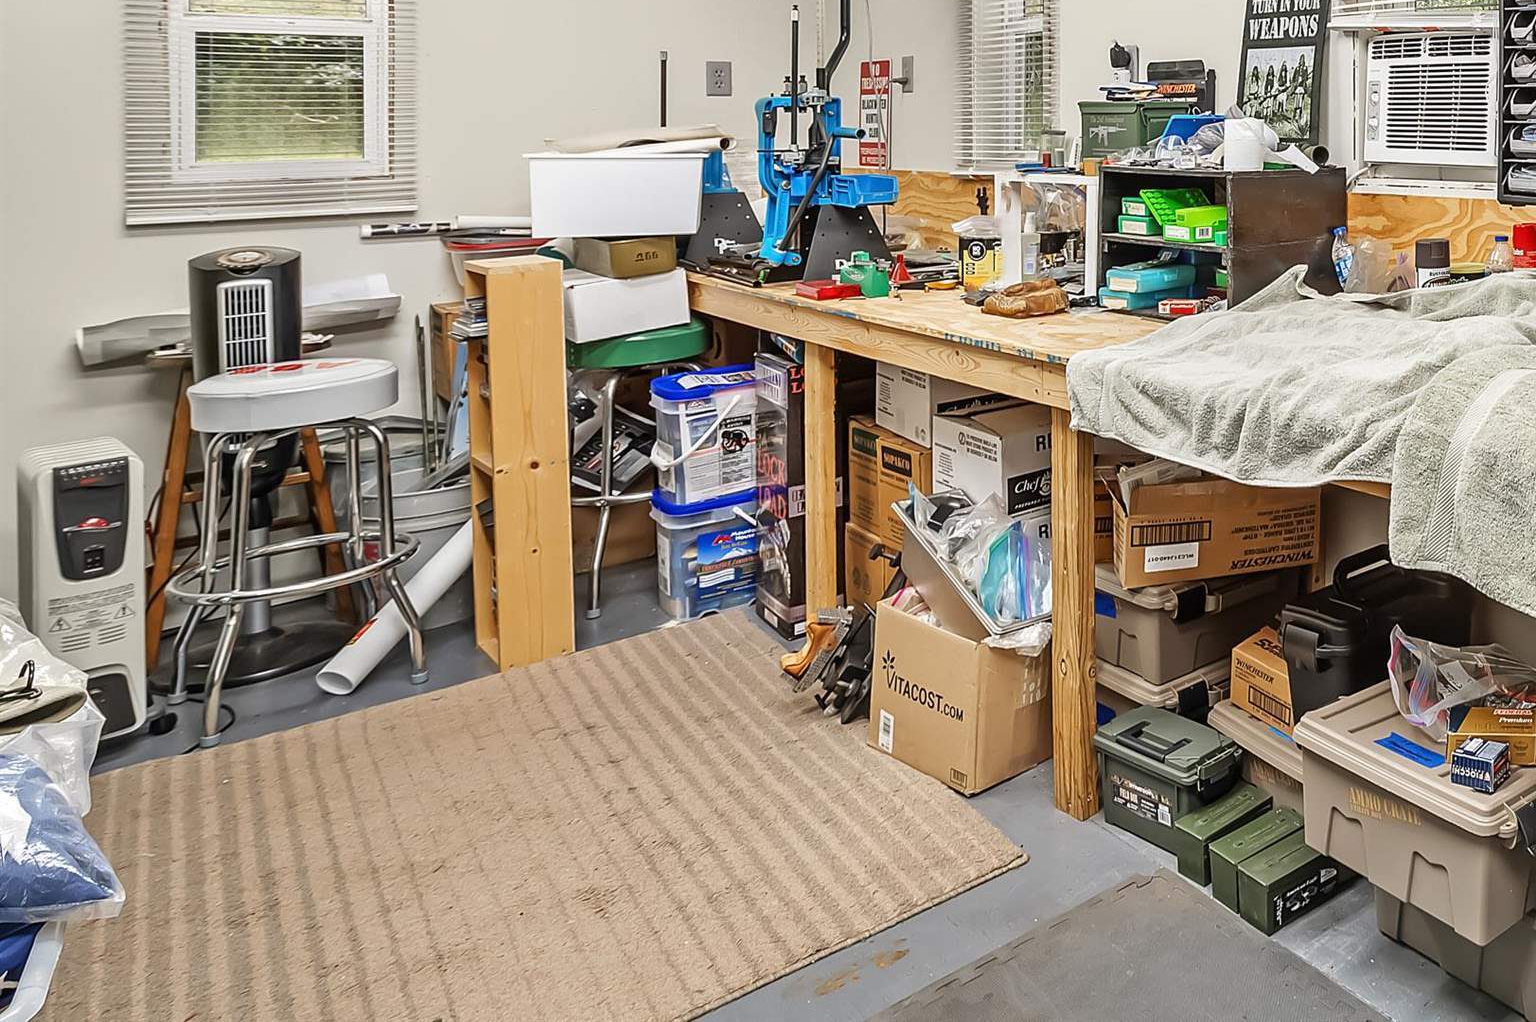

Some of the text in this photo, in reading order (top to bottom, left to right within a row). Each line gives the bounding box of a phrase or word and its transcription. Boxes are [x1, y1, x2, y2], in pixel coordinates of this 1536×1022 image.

[1249, 14, 1319, 40] WEAPONS
[1014, 476, 1041, 493] Chef
[1231, 550, 1314, 570] WINCHESTER
[1235, 658, 1275, 685] WINCHESTER
[887, 668, 964, 723] VITACOST.COM
[1349, 787, 1381, 812] AMMO
